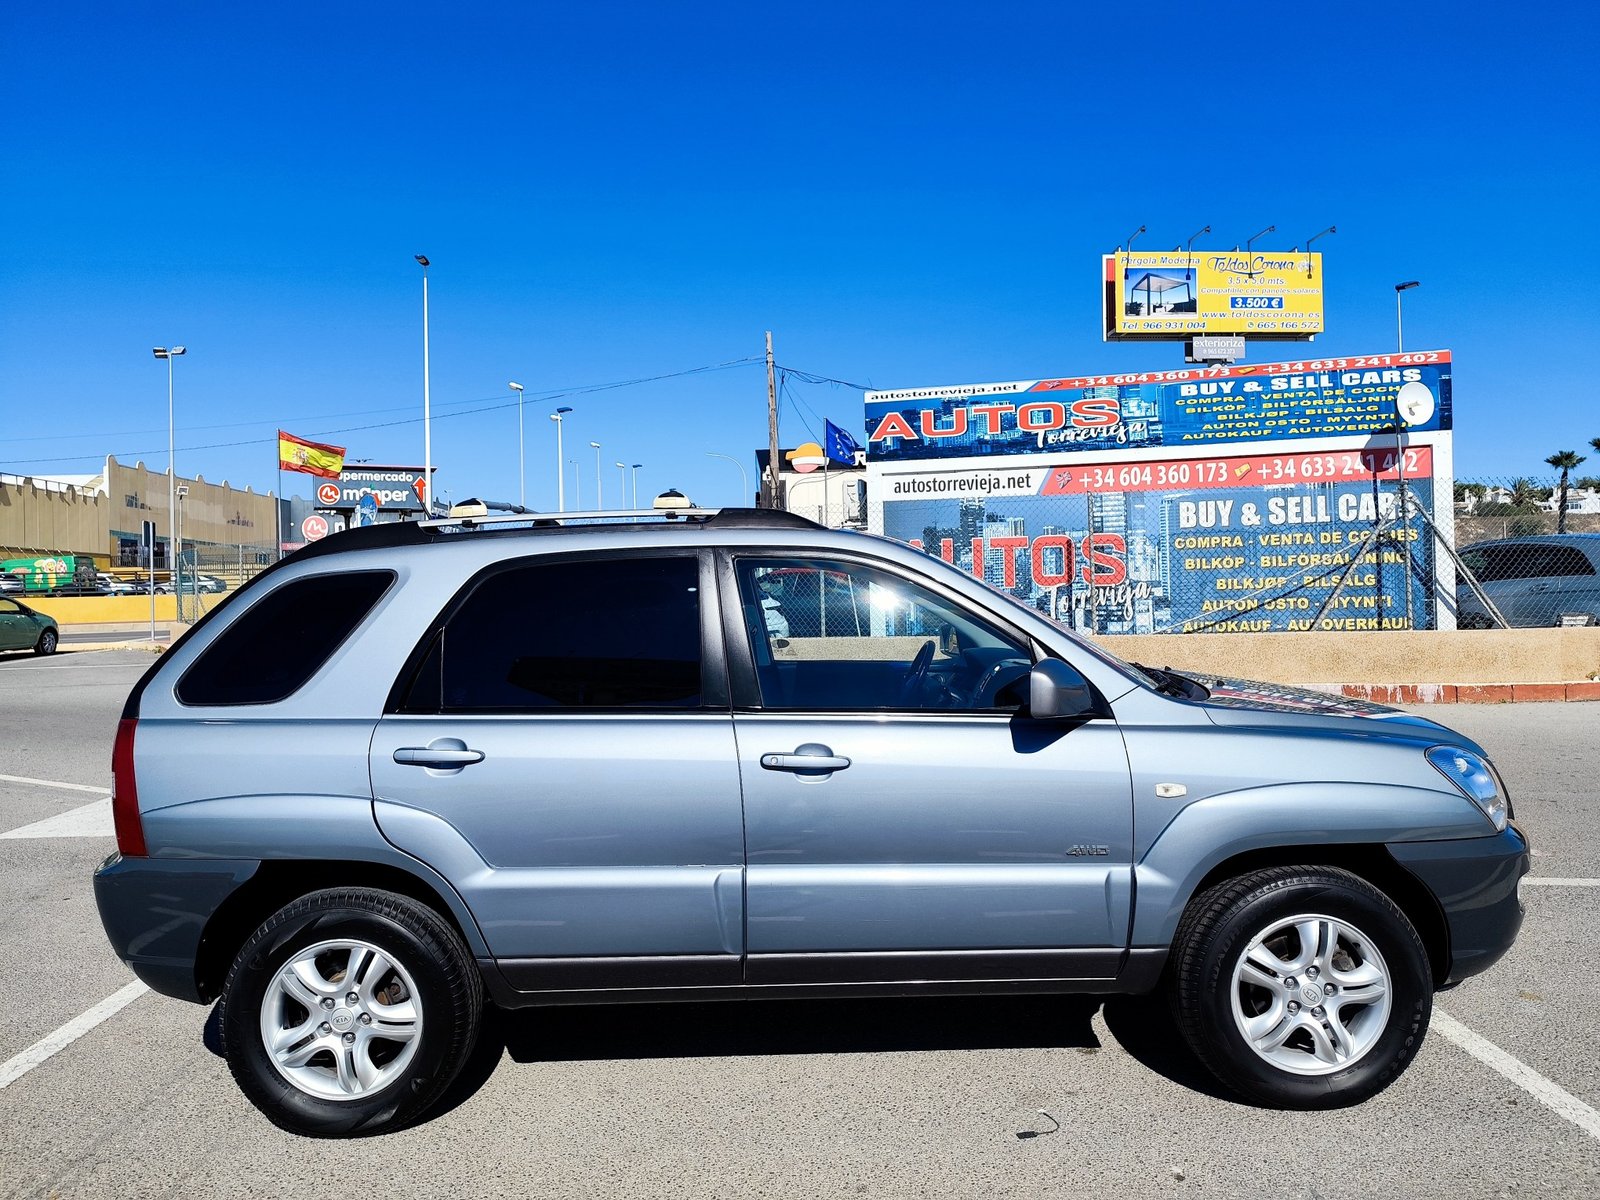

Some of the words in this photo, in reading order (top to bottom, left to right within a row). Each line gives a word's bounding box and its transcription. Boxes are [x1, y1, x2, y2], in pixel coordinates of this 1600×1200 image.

[1120, 257, 1157, 266] Pergola
[1207, 256, 1249, 273] Toldos
[1252, 256, 1295, 271] Corona
[1235, 298, 1268, 307] 3.500
[1143, 322, 1162, 330] 966
[1165, 322, 1183, 330] 931
[1257, 321, 1276, 329] 665
[1280, 321, 1298, 329] 166
[1193, 339, 1244, 348] exterioriza
[1263, 362, 1305, 373] +34
[1310, 360, 1348, 370] 633
[1354, 357, 1391, 367] 241
[1399, 353, 1439, 363] 402
[1070, 377, 1108, 388] +34
[1113, 374, 1148, 384] 604
[1154, 371, 1190, 381] 360
[1196, 368, 1231, 378] 173
[1180, 381, 1236, 397] BUY
[1243, 381, 1264, 392] &
[1270, 373, 1334, 391] SELL
[1341, 368, 1422, 386] CARS
[871, 384, 1019, 400] autostorrevieja.net
[1175, 395, 1245, 405] COMPRA
[1261, 391, 1317, 400] VENTA
[1351, 385, 1401, 395] COCH
[1185, 404, 1246, 414] BILKÖP
[1262, 395, 1396, 409] BILFÖRSÄLJNIN
[869, 398, 1121, 443] AUTOS
[1202, 421, 1259, 431] AUTON
[1265, 418, 1310, 427] OSTO
[1327, 413, 1395, 423] MYYNTI
[1217, 410, 1289, 421] BILKJØP
[1034, 421, 1147, 449] Torrevieja
[1182, 429, 1272, 440] AUTOKAUF
[1257, 458, 1296, 479] +34
[1301, 456, 1336, 477] 633
[1341, 453, 1375, 475] 241
[339, 472, 413, 482] permercado
[894, 473, 1032, 494] autostorrevieja.net
[1079, 468, 1115, 488] +34
[1119, 466, 1152, 486] 604
[1157, 464, 1190, 485] 360
[1195, 462, 1228, 483] 173
[1179, 500, 1234, 528] BUY
[1240, 502, 1261, 526] &
[1267, 495, 1331, 525] SELL
[1174, 536, 1243, 549] COMPRA
[1259, 532, 1314, 546] VENTA
[1320, 531, 1342, 544] DE
[1185, 555, 1245, 570] BILKÖP
[1216, 576, 1287, 590] BILKJØP
[1202, 599, 1258, 611] AUTON
[1264, 598, 1309, 610] OSTO
[1287, 617, 1408, 631] AUOVERKAU
